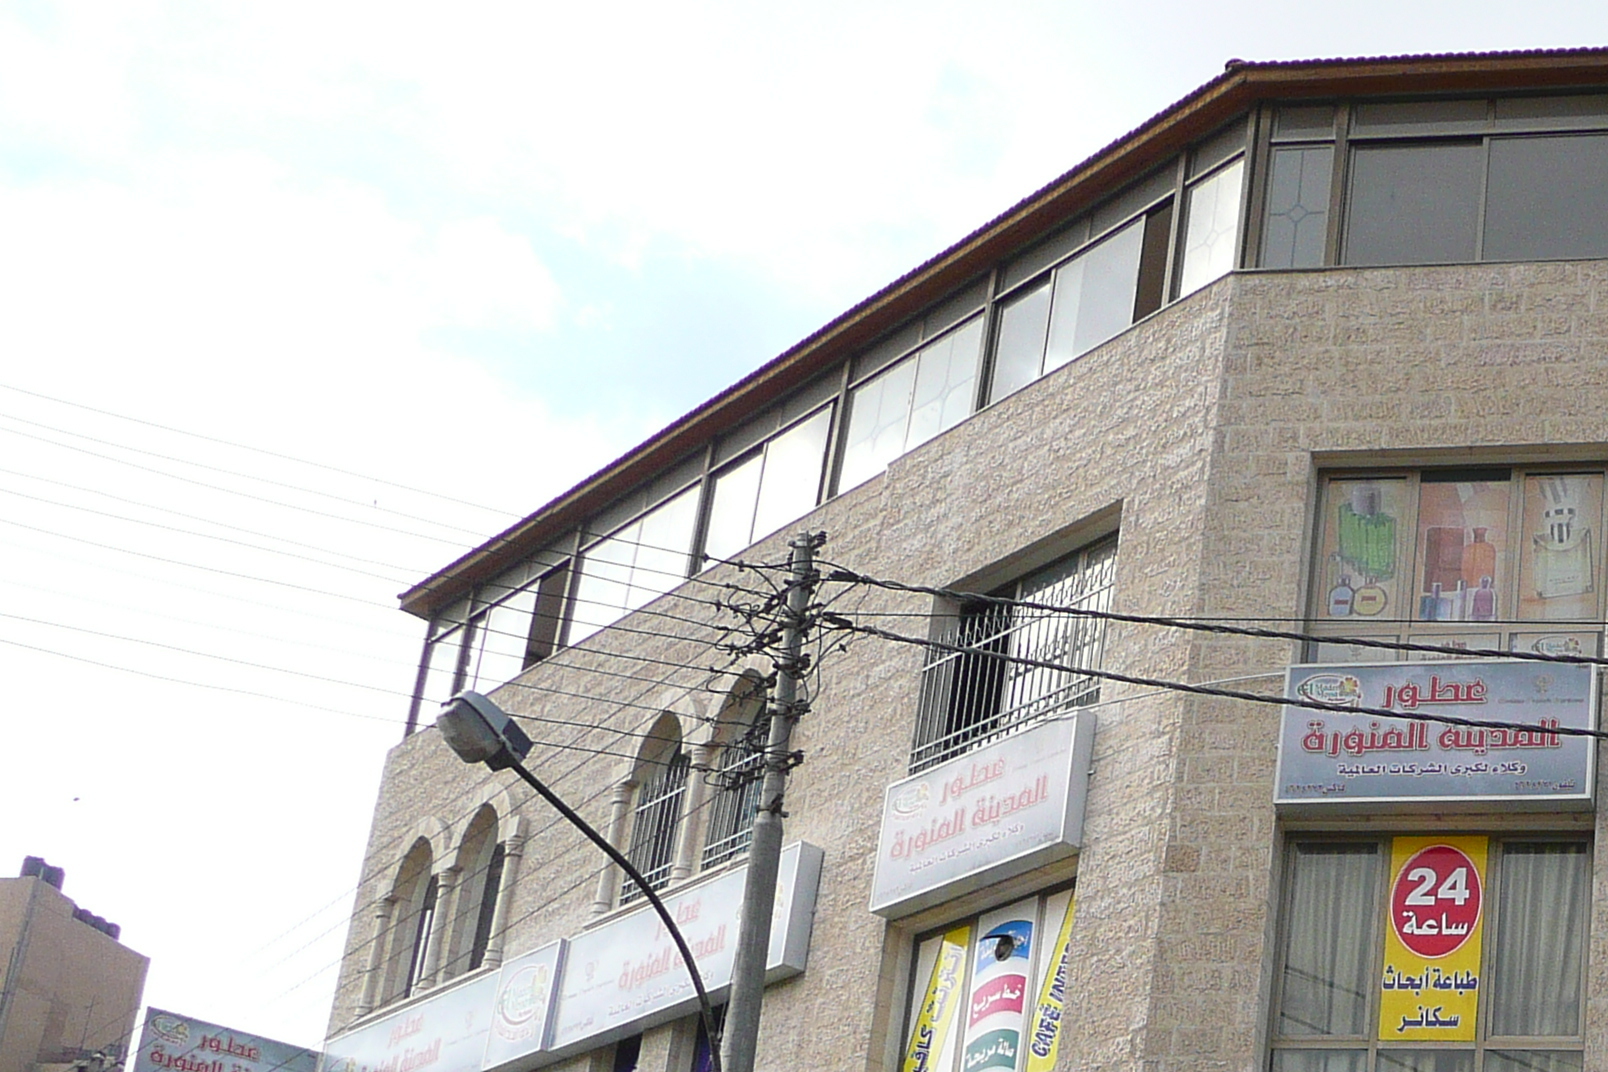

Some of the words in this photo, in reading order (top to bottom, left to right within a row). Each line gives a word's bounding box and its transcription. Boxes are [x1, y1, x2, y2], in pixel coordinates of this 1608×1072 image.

[1382, 674, 1488, 709] عطور
[1302, 720, 1429, 755] المنورة
[1438, 718, 1561, 755] المدينة
[940, 757, 1004, 805] عطور
[1338, 763, 1385, 776] العالمية
[1390, 762, 1447, 775] الشركات
[971, 772, 1048, 826] المدينة
[891, 808, 965, 859] المنورة
[1405, 867, 1470, 906] 24
[1402, 910, 1468, 936] ساعة
[1001, 983, 1022, 1000] خط
[1382, 965, 1430, 997] أبحاث
[1432, 967, 1478, 995] طباعة
[973, 991, 1001, 1018] سريع
[1397, 1005, 1459, 1033] سكانر
[200, 1034, 261, 1063] عطور
[966, 1044, 995, 1069] مريحة
[997, 1038, 1015, 1058] صالة
